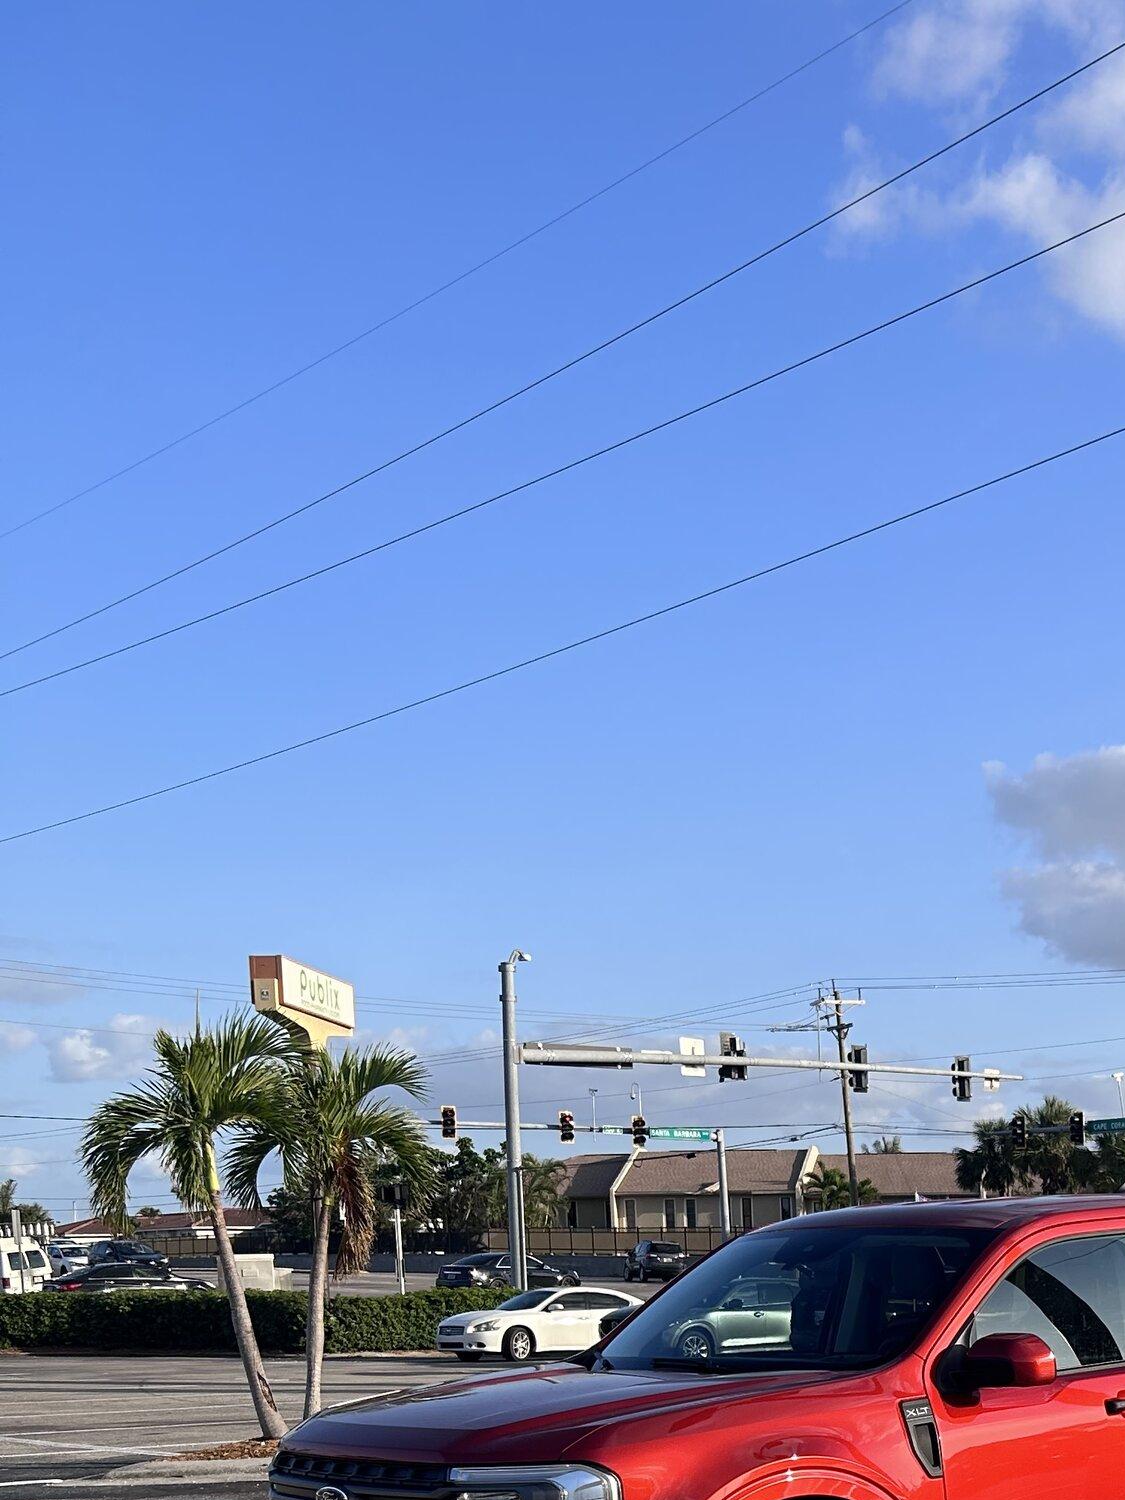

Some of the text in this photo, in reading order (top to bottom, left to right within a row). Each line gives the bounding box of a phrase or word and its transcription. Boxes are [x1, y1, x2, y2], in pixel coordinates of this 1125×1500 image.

[299, 969, 340, 1010] Publix
[1093, 1122, 1107, 1131] CAPE
[651, 1128, 670, 1137] SANTA
[673, 1130, 702, 1138] BARBARA
[906, 1407, 929, 1418] XLT
